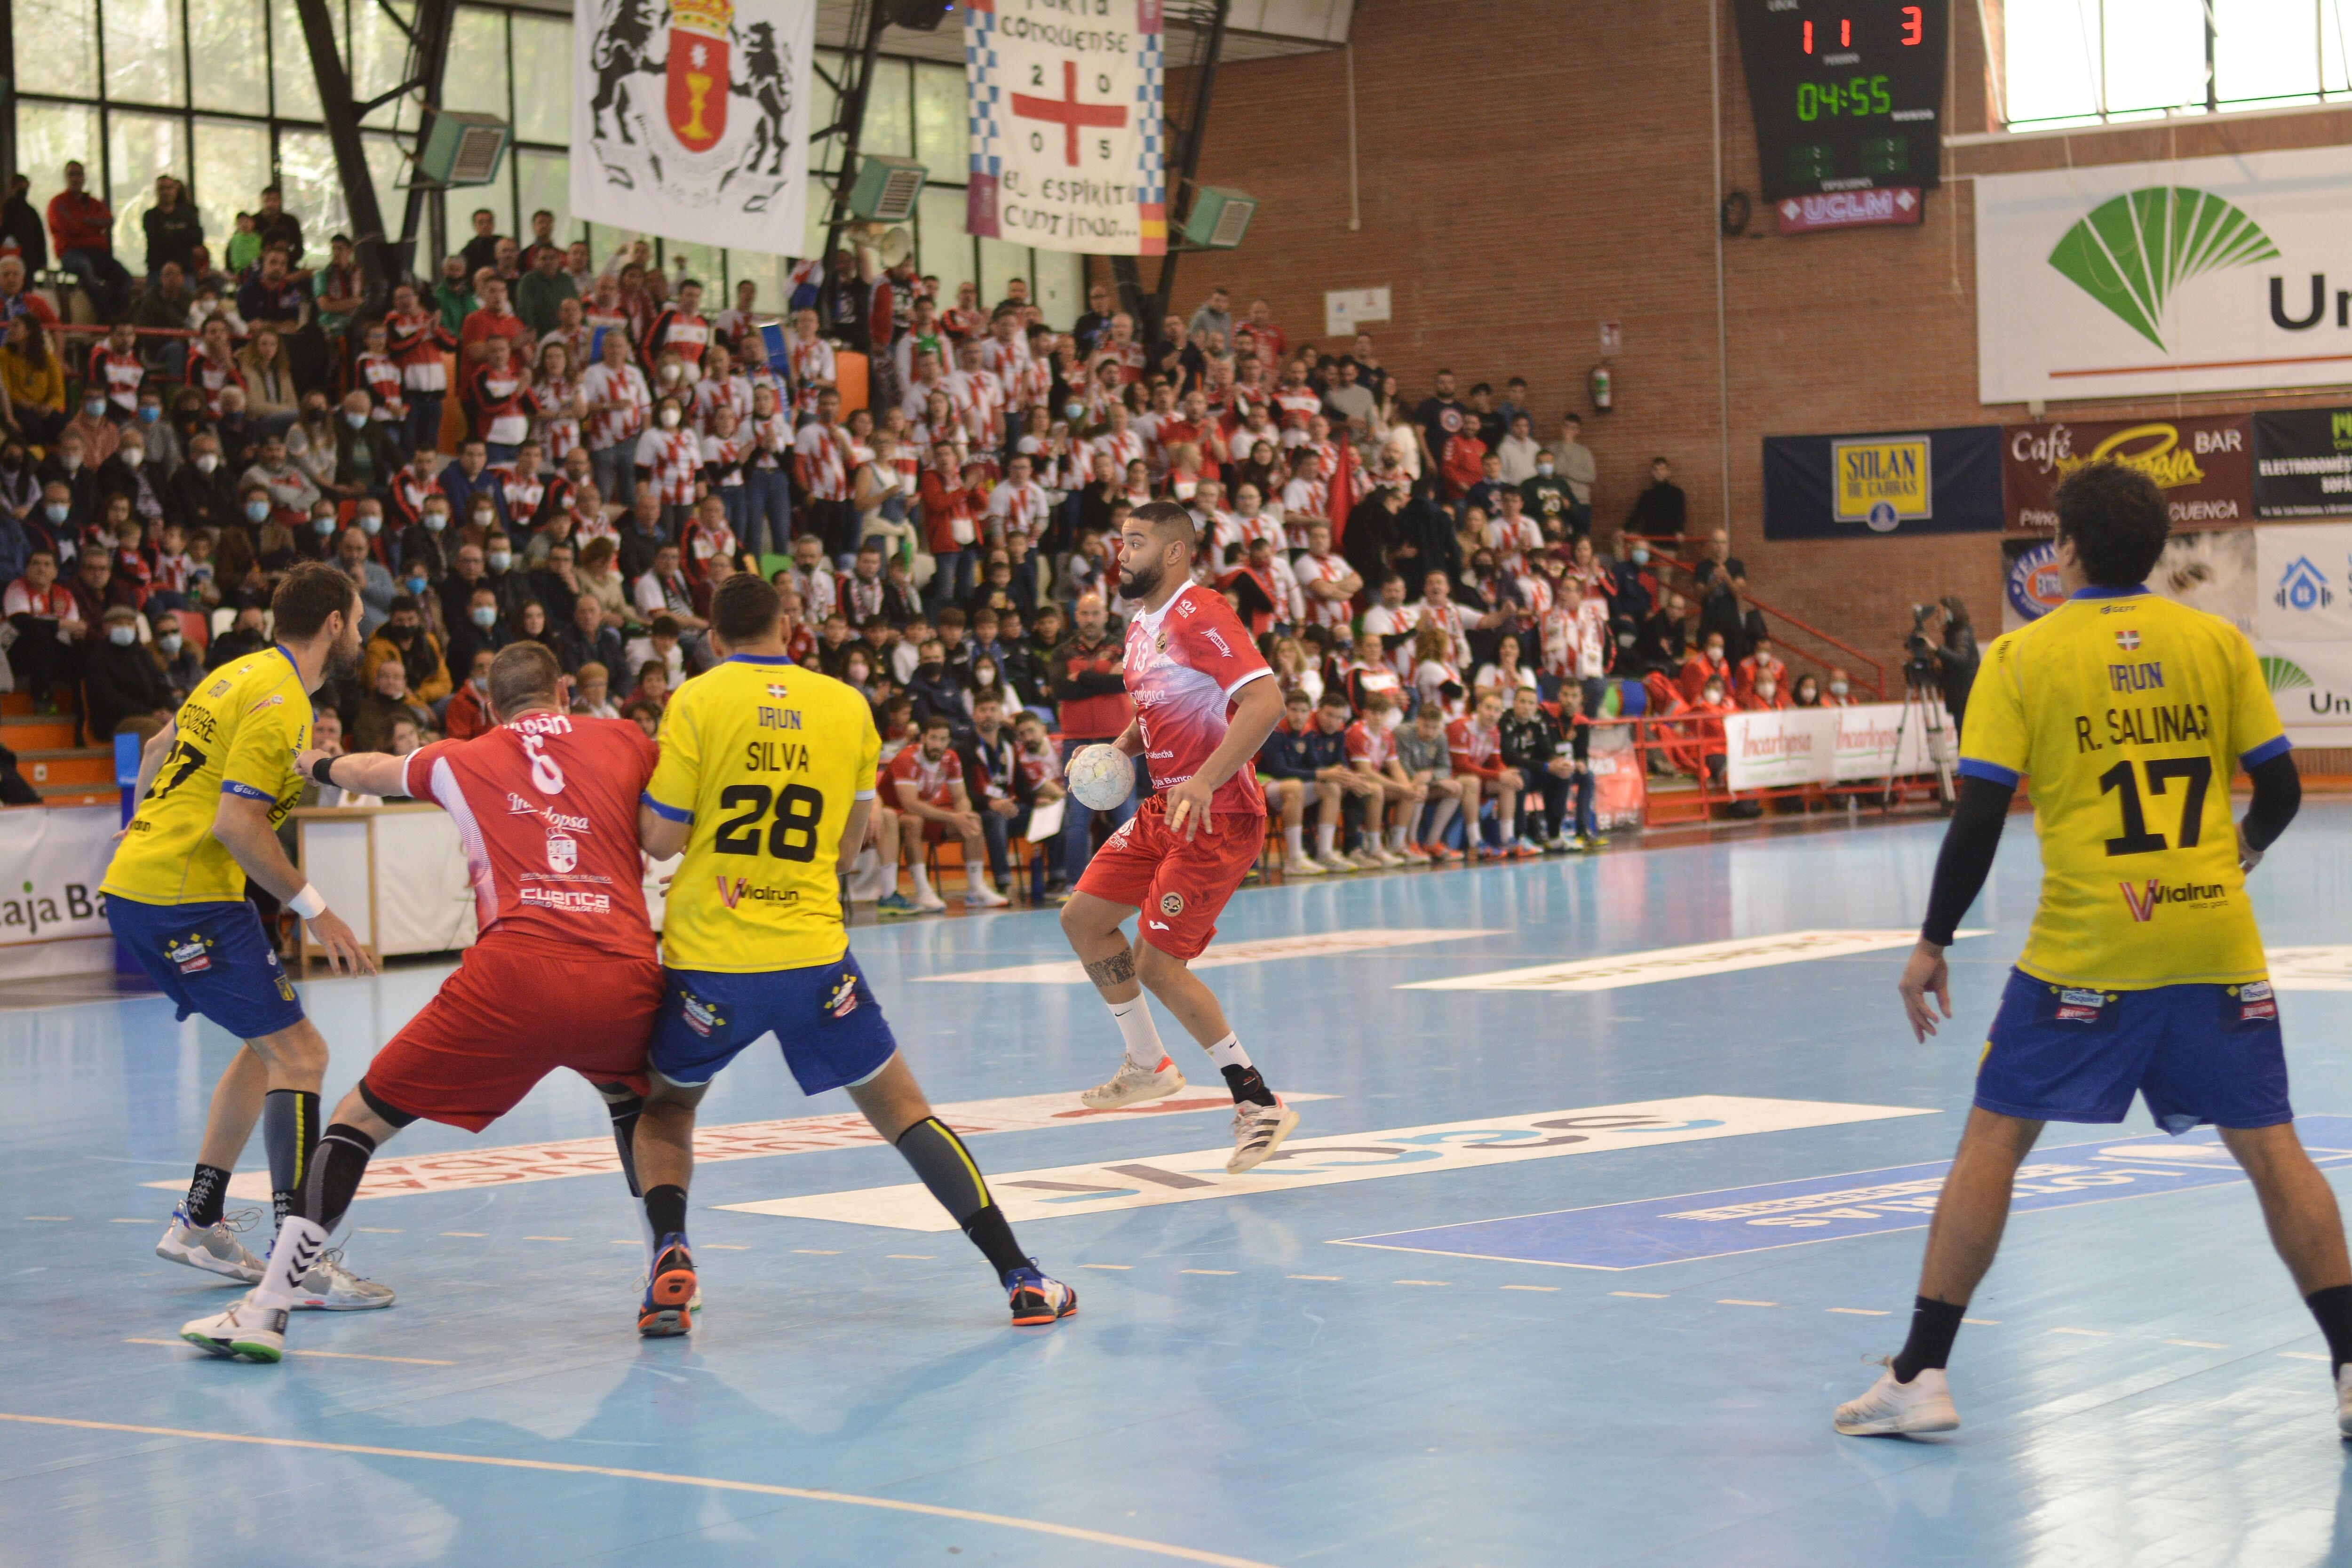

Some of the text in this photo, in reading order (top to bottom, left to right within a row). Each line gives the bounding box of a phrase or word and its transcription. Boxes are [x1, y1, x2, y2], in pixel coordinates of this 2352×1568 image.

[1901, 6, 1922, 46] 3
[1031, 64, 1111, 93] 2 0
[1796, 75, 1892, 121] 04:55
[1030, 132, 1111, 160] 0 5
[1804, 191, 1893, 223] UCLM
[2012, 424, 2072, 474] Café
[2194, 429, 2242, 454] BAR
[2167, 499, 2239, 521] CUENCA
[1133, 641, 1149, 672] 13
[2108, 661, 2165, 694] IRUN
[758, 706, 802, 730] IRUN
[2075, 715, 2103, 754] R.
[523, 735, 566, 795] 6
[747, 741, 810, 773] SILVA
[714, 783, 824, 863] 28
[2098, 756, 2212, 857] 17
[0, 881, 61, 935] aja
[1699, 1188, 1901, 1218] DEPORTE
[1745, 1169, 2188, 1228] LOTRÍAS
